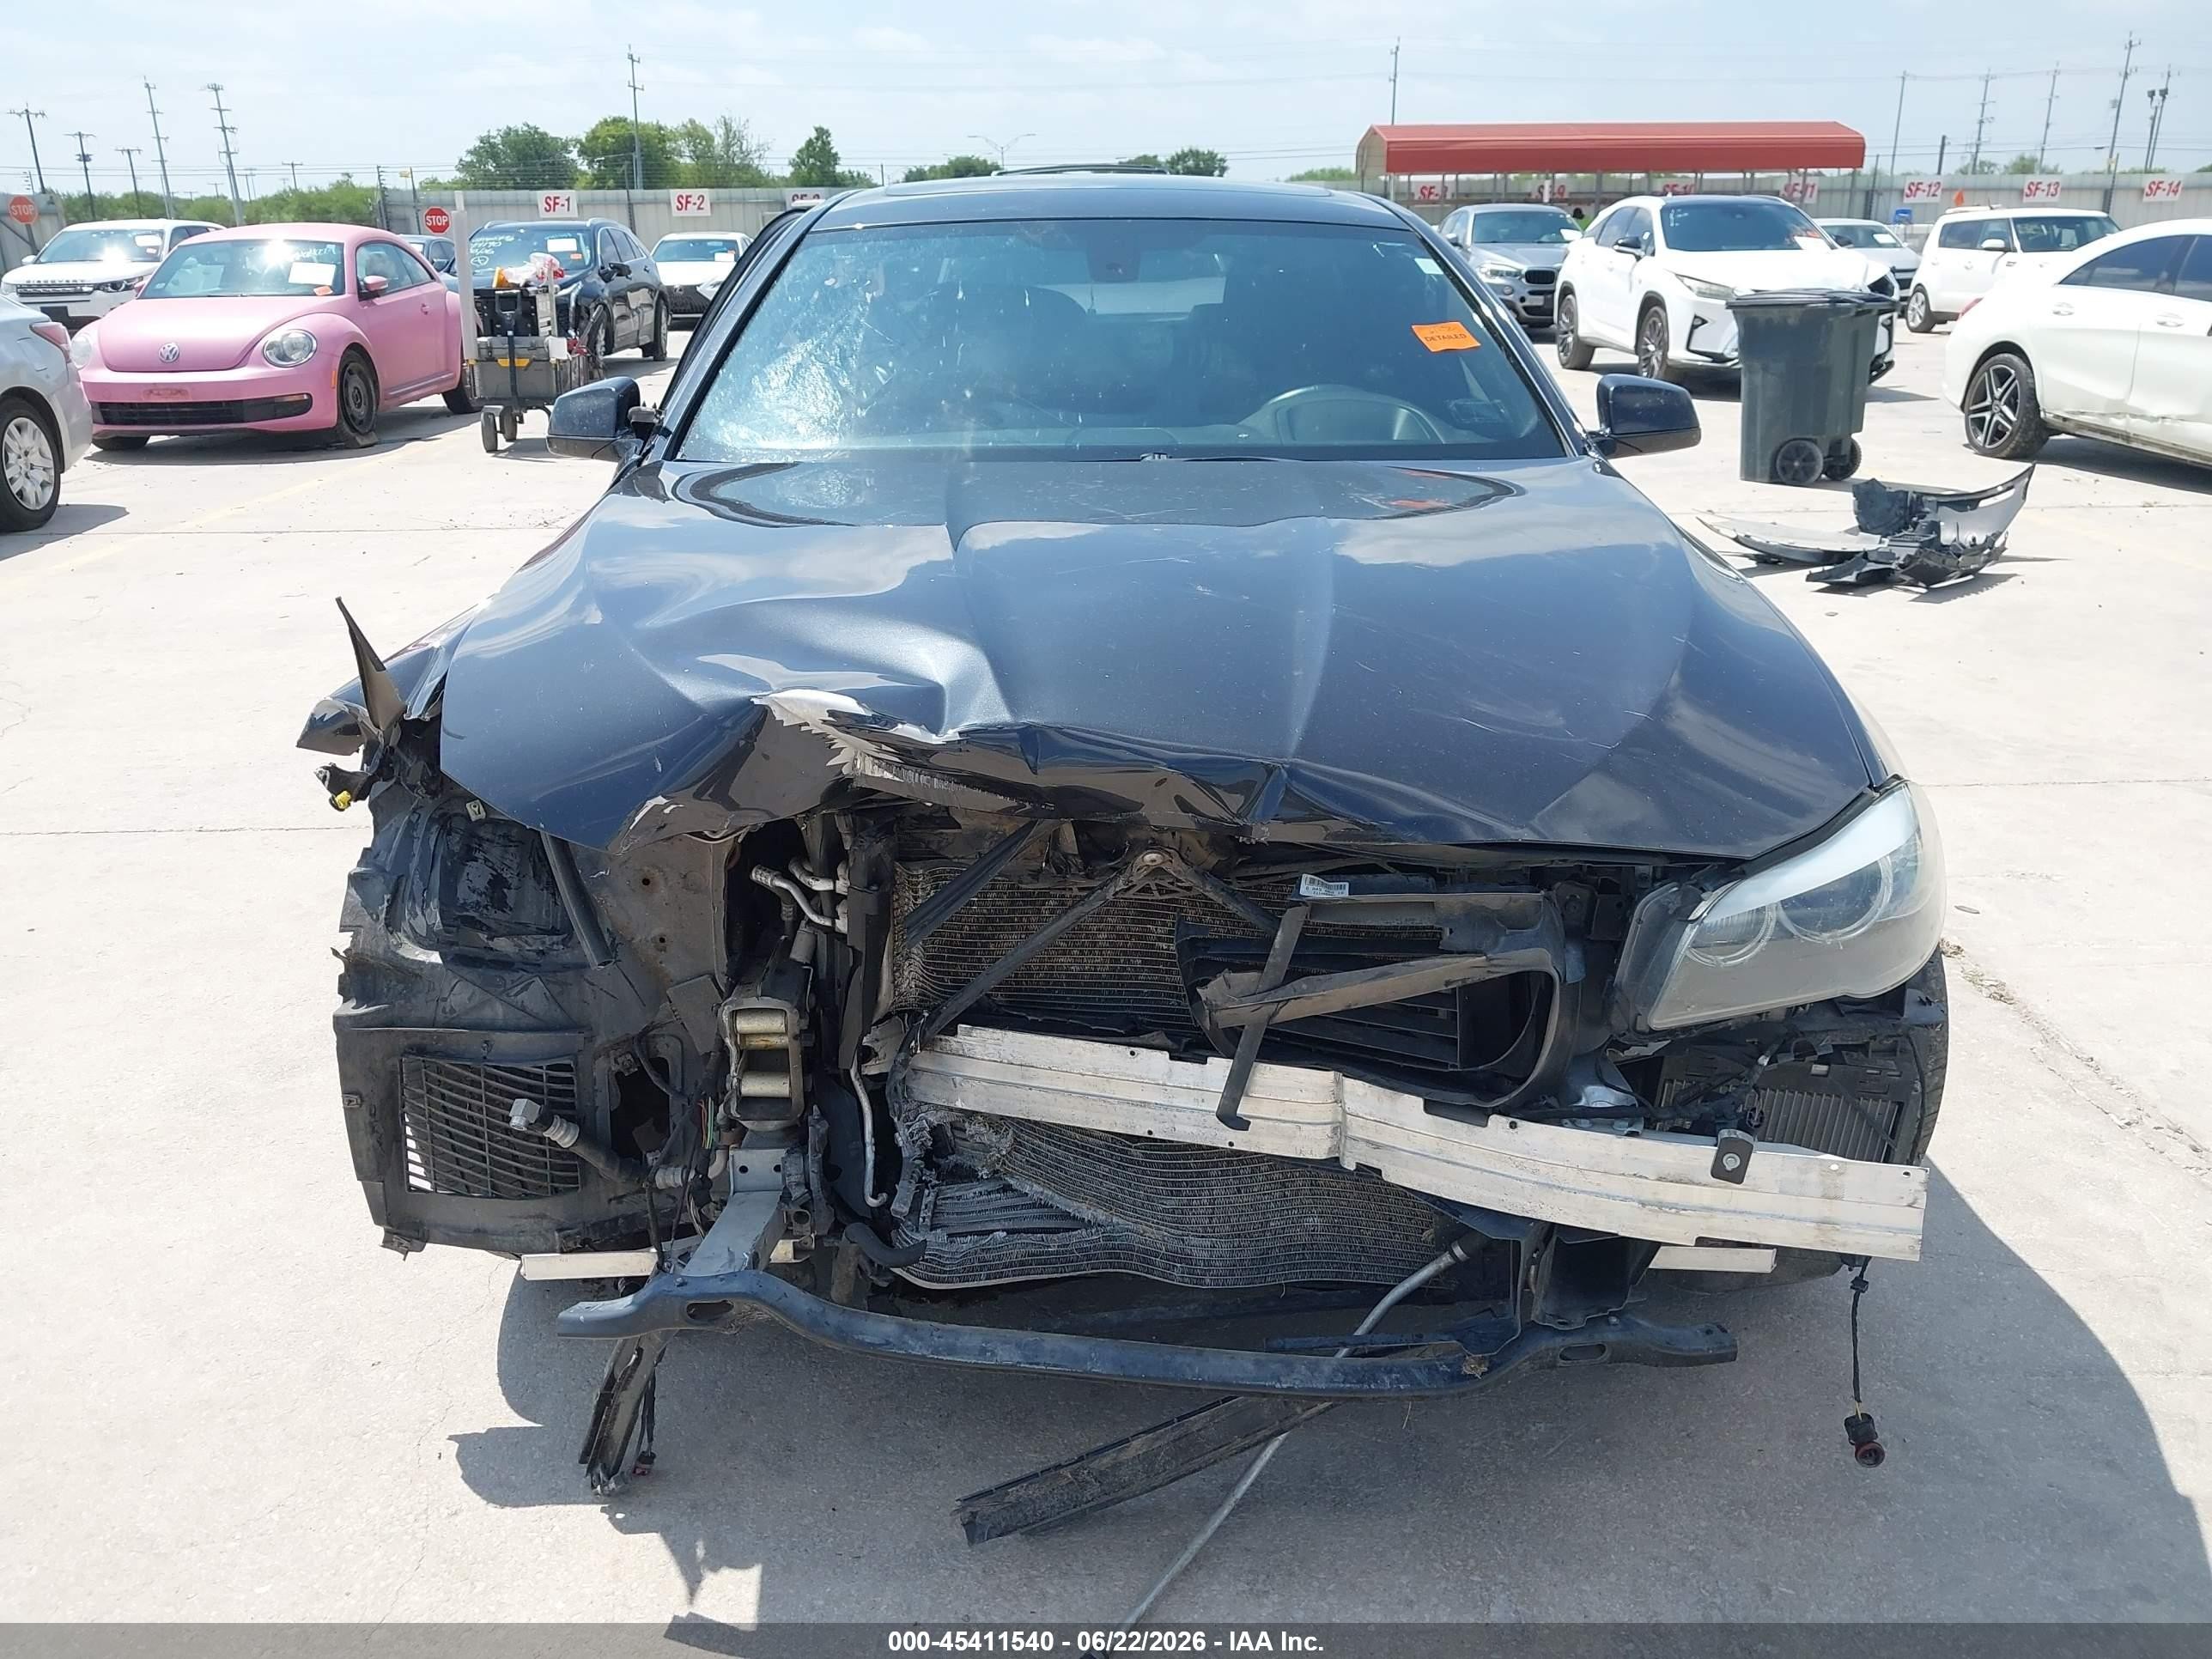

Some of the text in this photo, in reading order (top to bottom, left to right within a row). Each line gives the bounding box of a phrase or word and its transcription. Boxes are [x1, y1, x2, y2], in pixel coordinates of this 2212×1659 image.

[1905, 181, 1942, 198] SF-12
[2025, 181, 2061, 198] SF-13
[2145, 180, 2182, 197] SF-14
[10, 205, 34, 216] STOP
[544, 196, 571, 213] SF-1
[676, 194, 705, 211] SF-2
[425, 216, 448, 227] STOP
[1425, 333, 1468, 342] DETAILED
